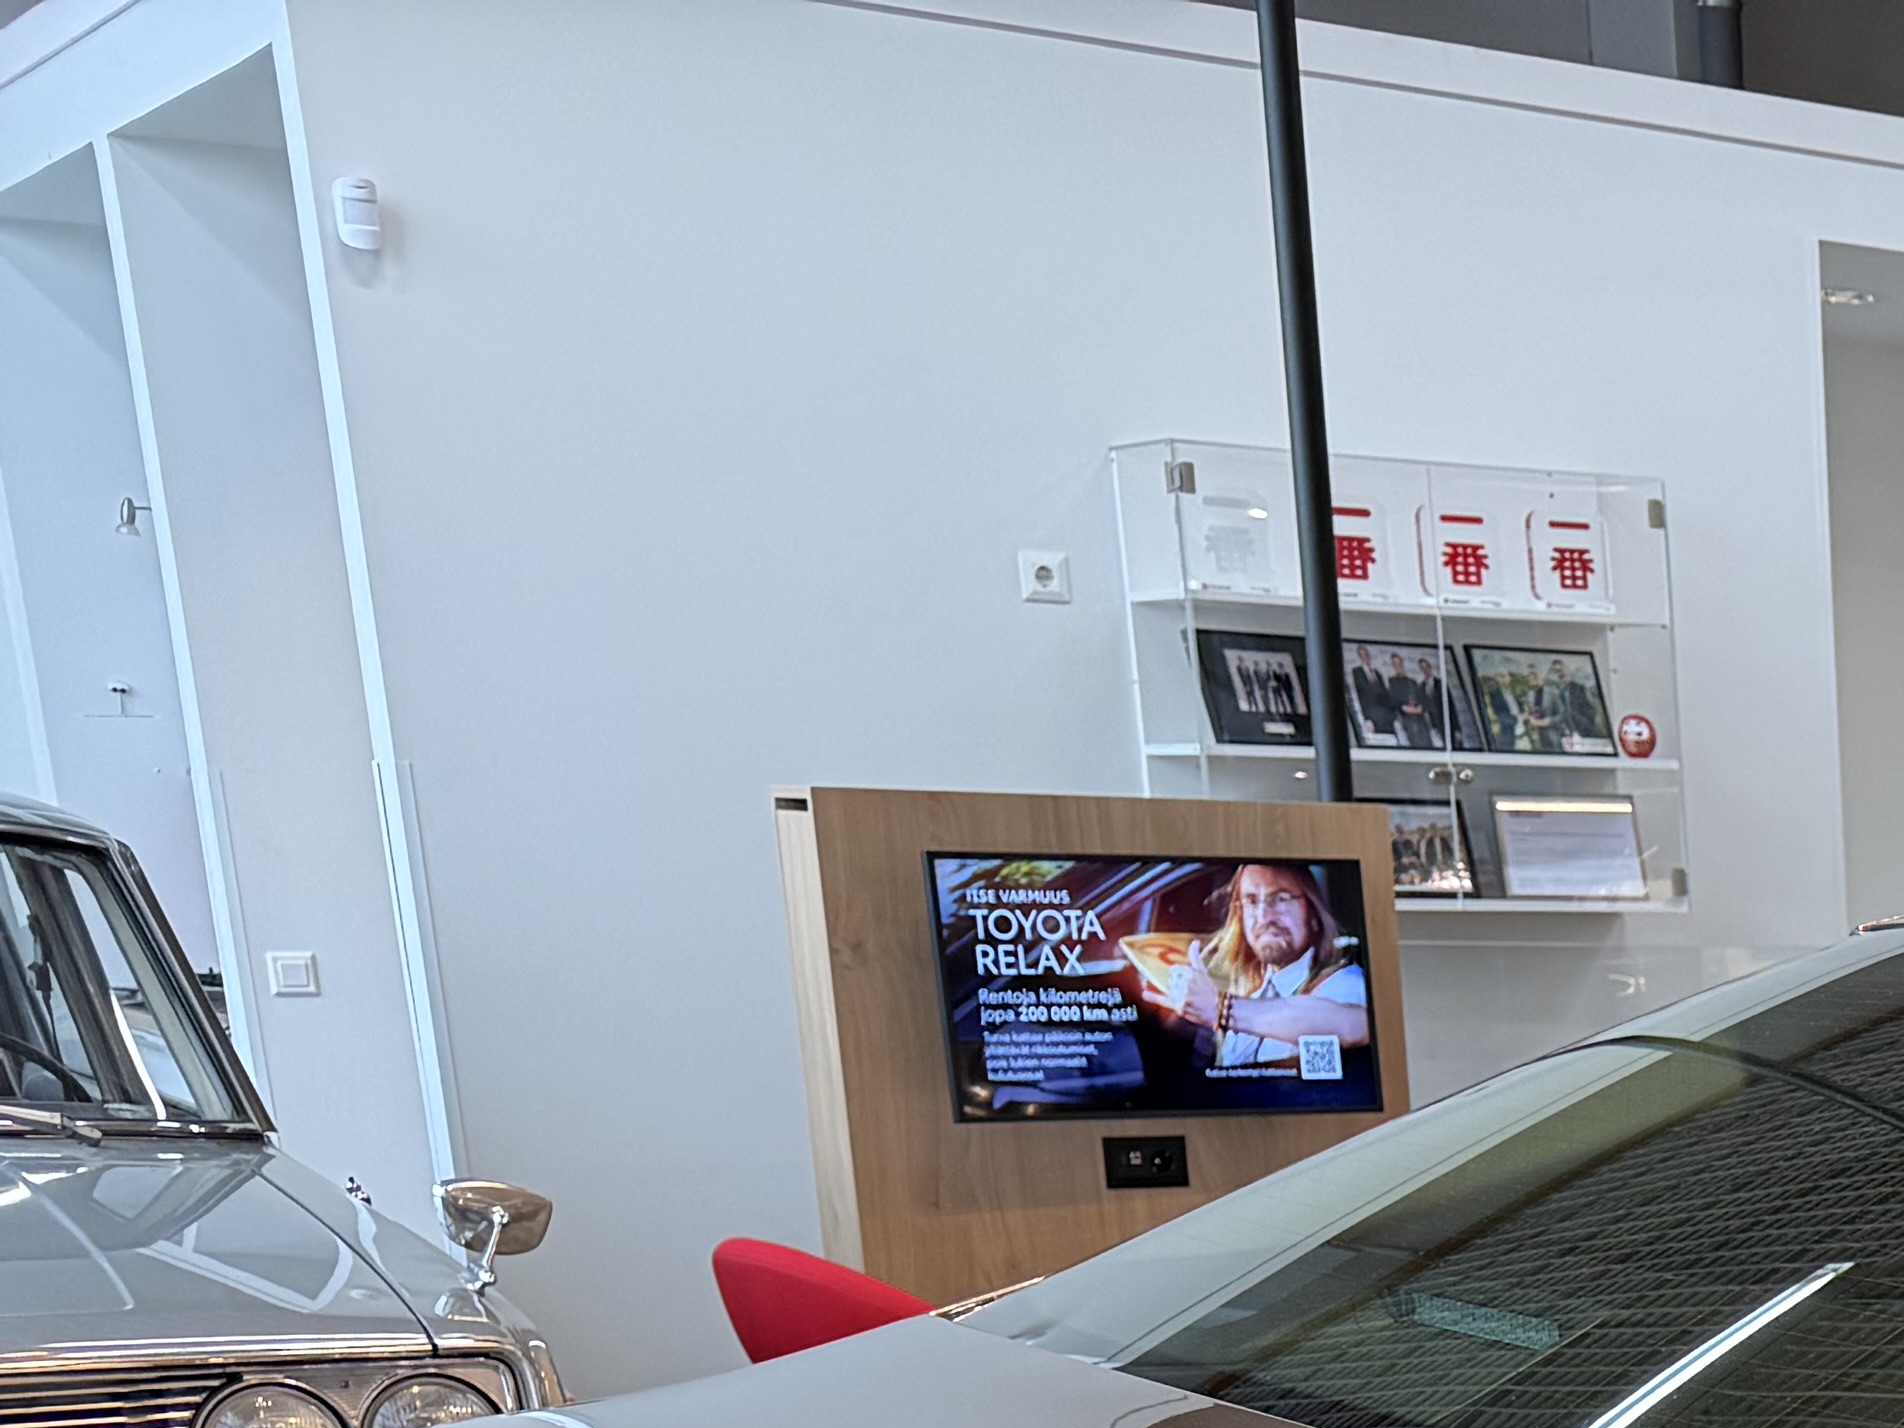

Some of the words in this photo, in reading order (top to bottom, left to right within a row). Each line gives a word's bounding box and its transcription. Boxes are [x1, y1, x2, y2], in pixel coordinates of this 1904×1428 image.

[1439, 514, 1489, 586] 一番
[1548, 520, 1595, 590] 一番
[999, 889, 1070, 905] VARMUUS
[968, 908, 1106, 940] TOYOTA
[975, 943, 1084, 976] RELAX
[978, 987, 1037, 1006] Rentoja
[1039, 987, 1122, 1007] kilometrejä
[980, 1006, 1015, 1026] jopa
[1019, 1006, 1048, 1022] 200
[1050, 1006, 1080, 1022] 000
[1082, 1005, 1109, 1021] km
[1110, 1005, 1139, 1022] asti
